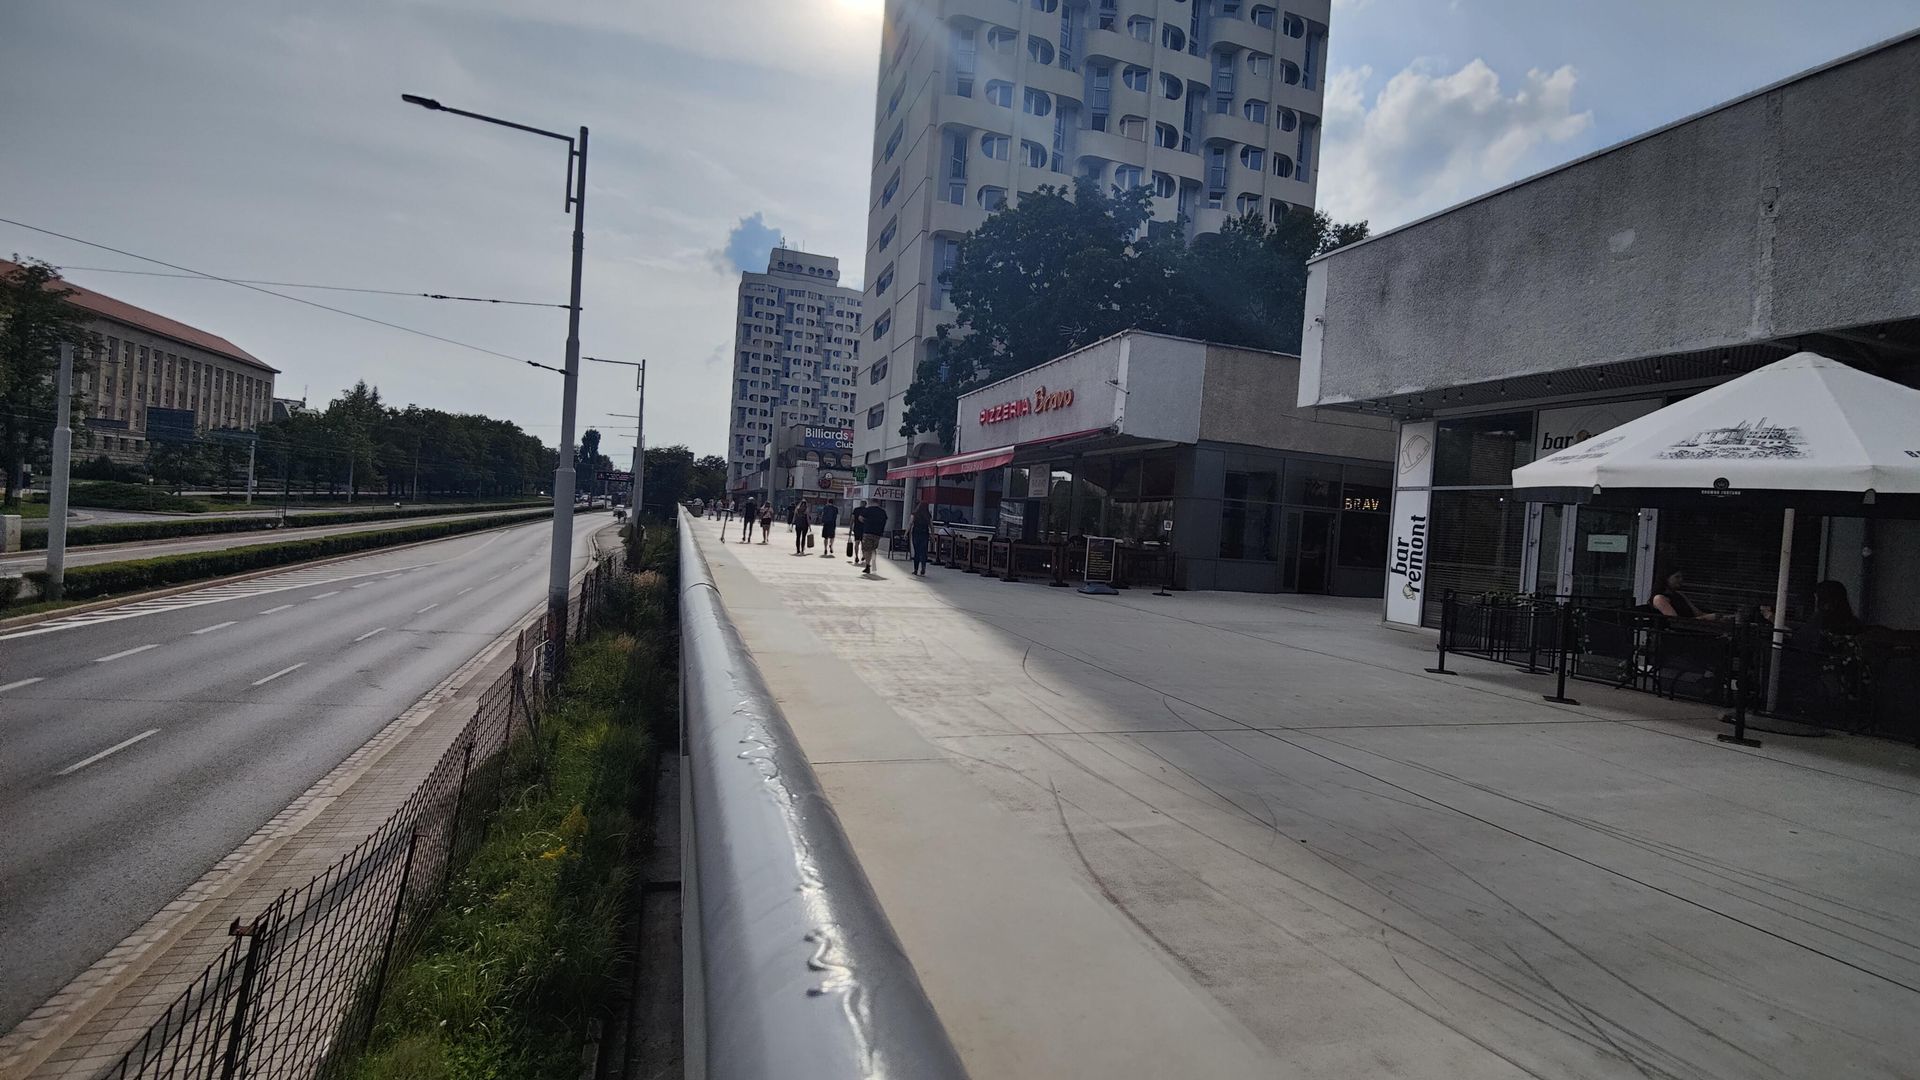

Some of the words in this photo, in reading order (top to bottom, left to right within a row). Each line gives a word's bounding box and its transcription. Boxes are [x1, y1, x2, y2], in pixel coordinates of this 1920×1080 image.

[980, 398, 1031, 425] PIZZERIA
[1034, 385, 1074, 414] Bravo
[805, 427, 848, 440] Billiards
[835, 441, 853, 449] Club
[1541, 432, 1573, 450] bar
[1391, 537, 1409, 577] bar
[1408, 515, 1426, 593] remont
